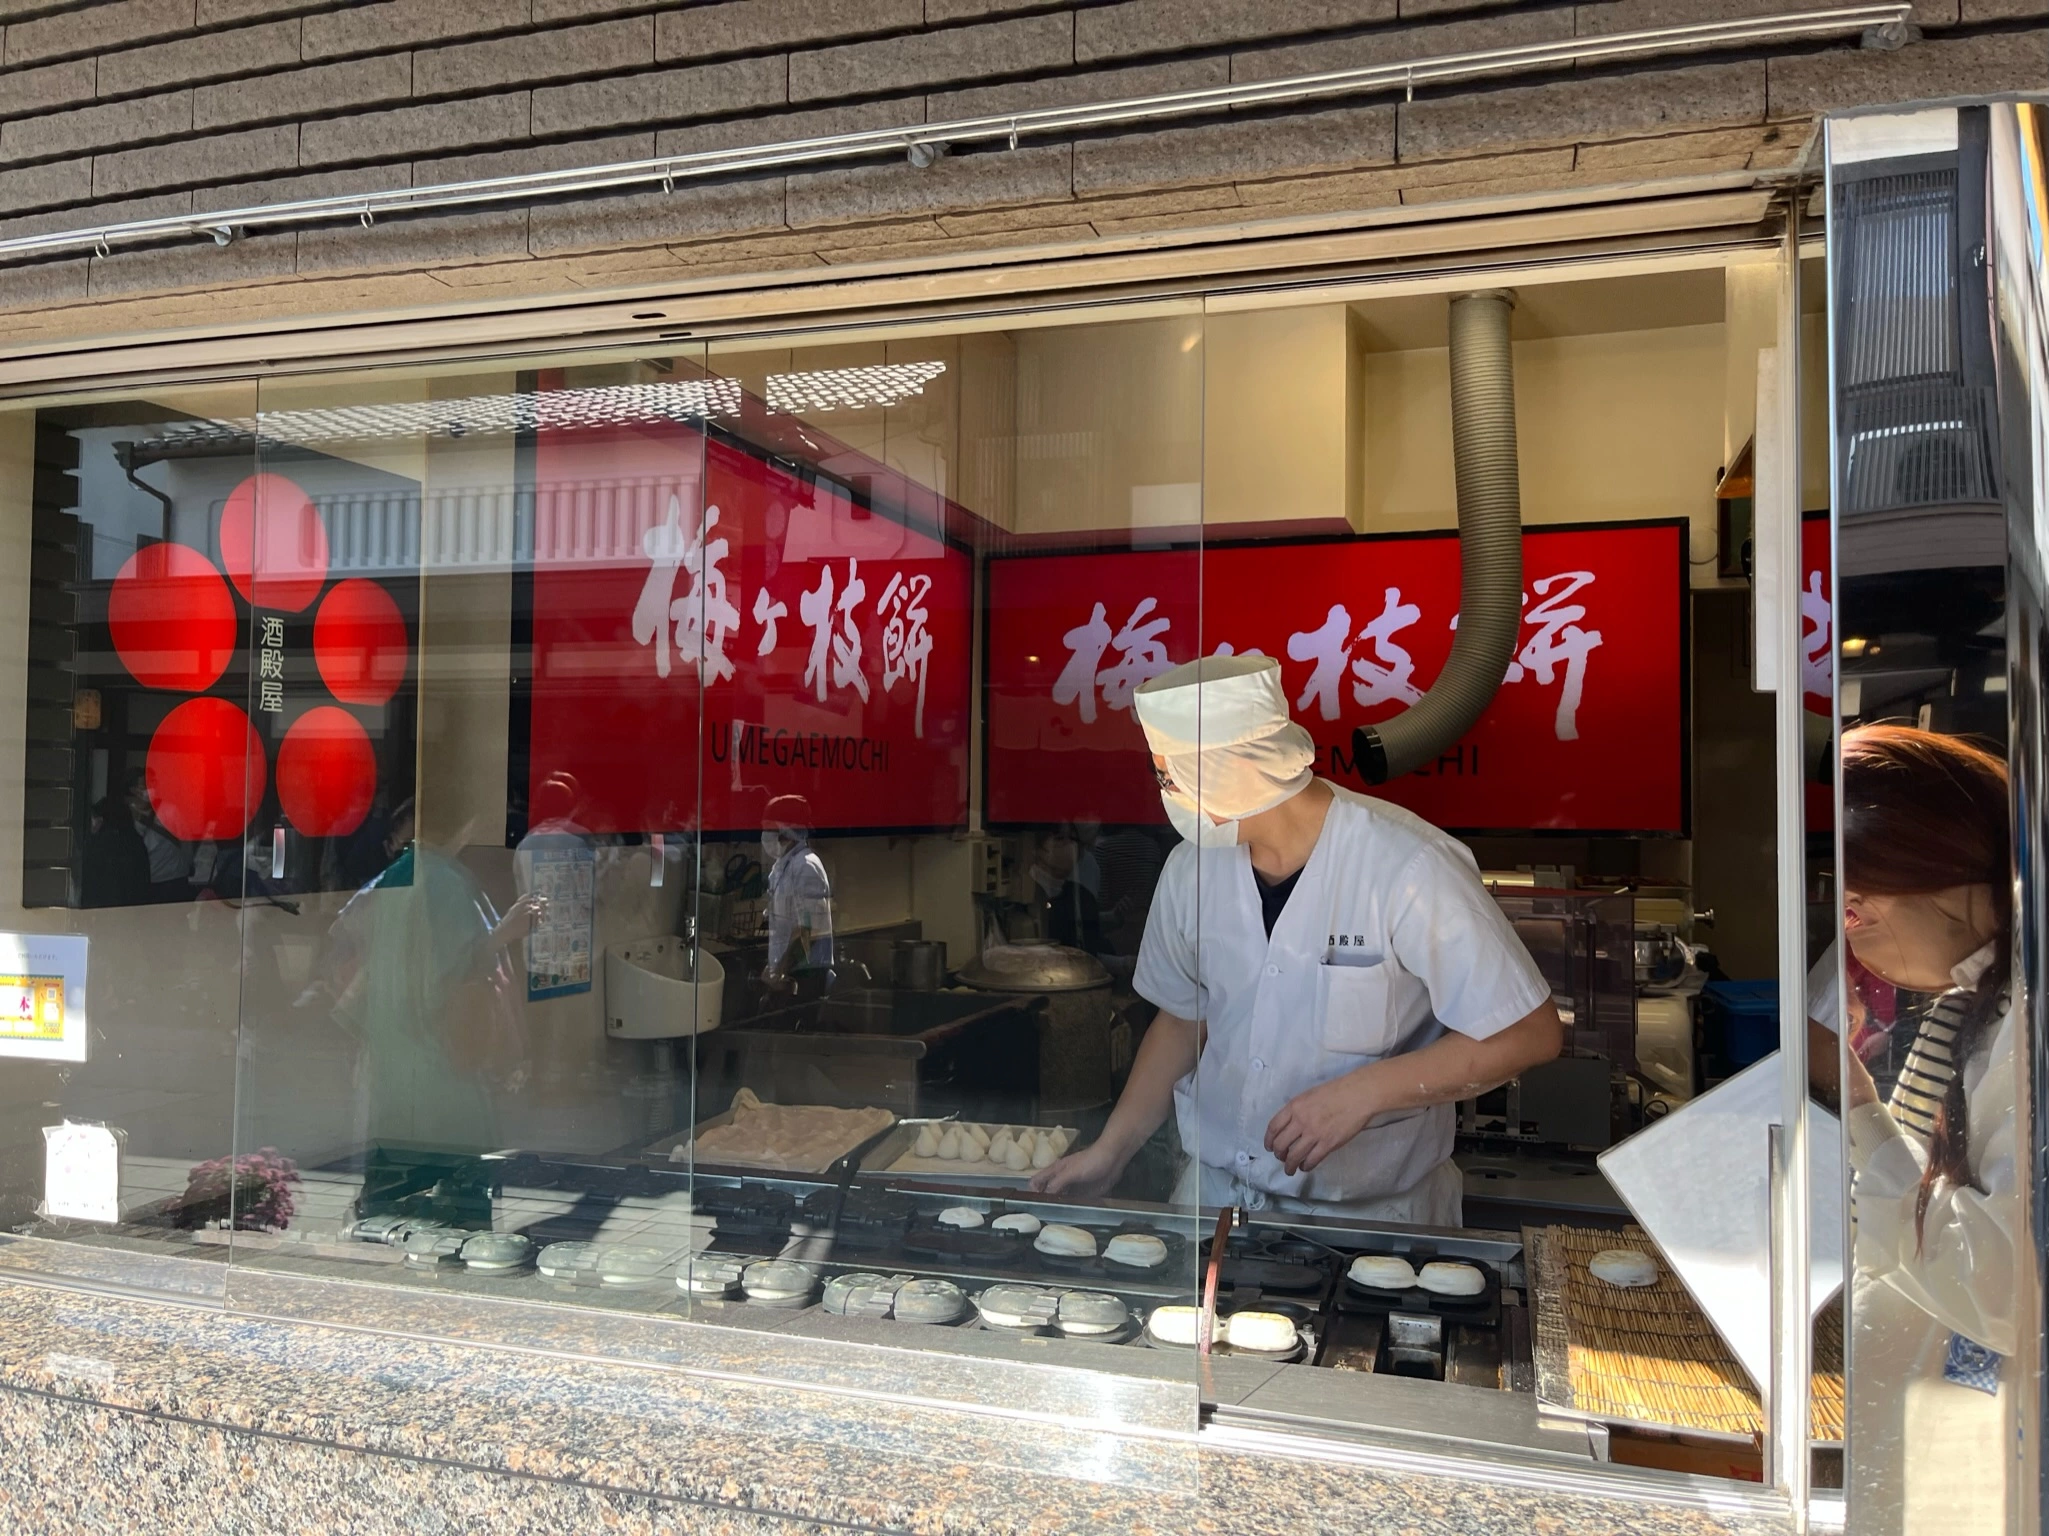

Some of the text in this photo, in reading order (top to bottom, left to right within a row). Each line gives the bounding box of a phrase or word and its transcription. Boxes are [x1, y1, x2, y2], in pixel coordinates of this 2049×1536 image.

[259, 615, 285, 713] 酒殿屋
[710, 721, 890, 773] UMEGAEMOCHI
